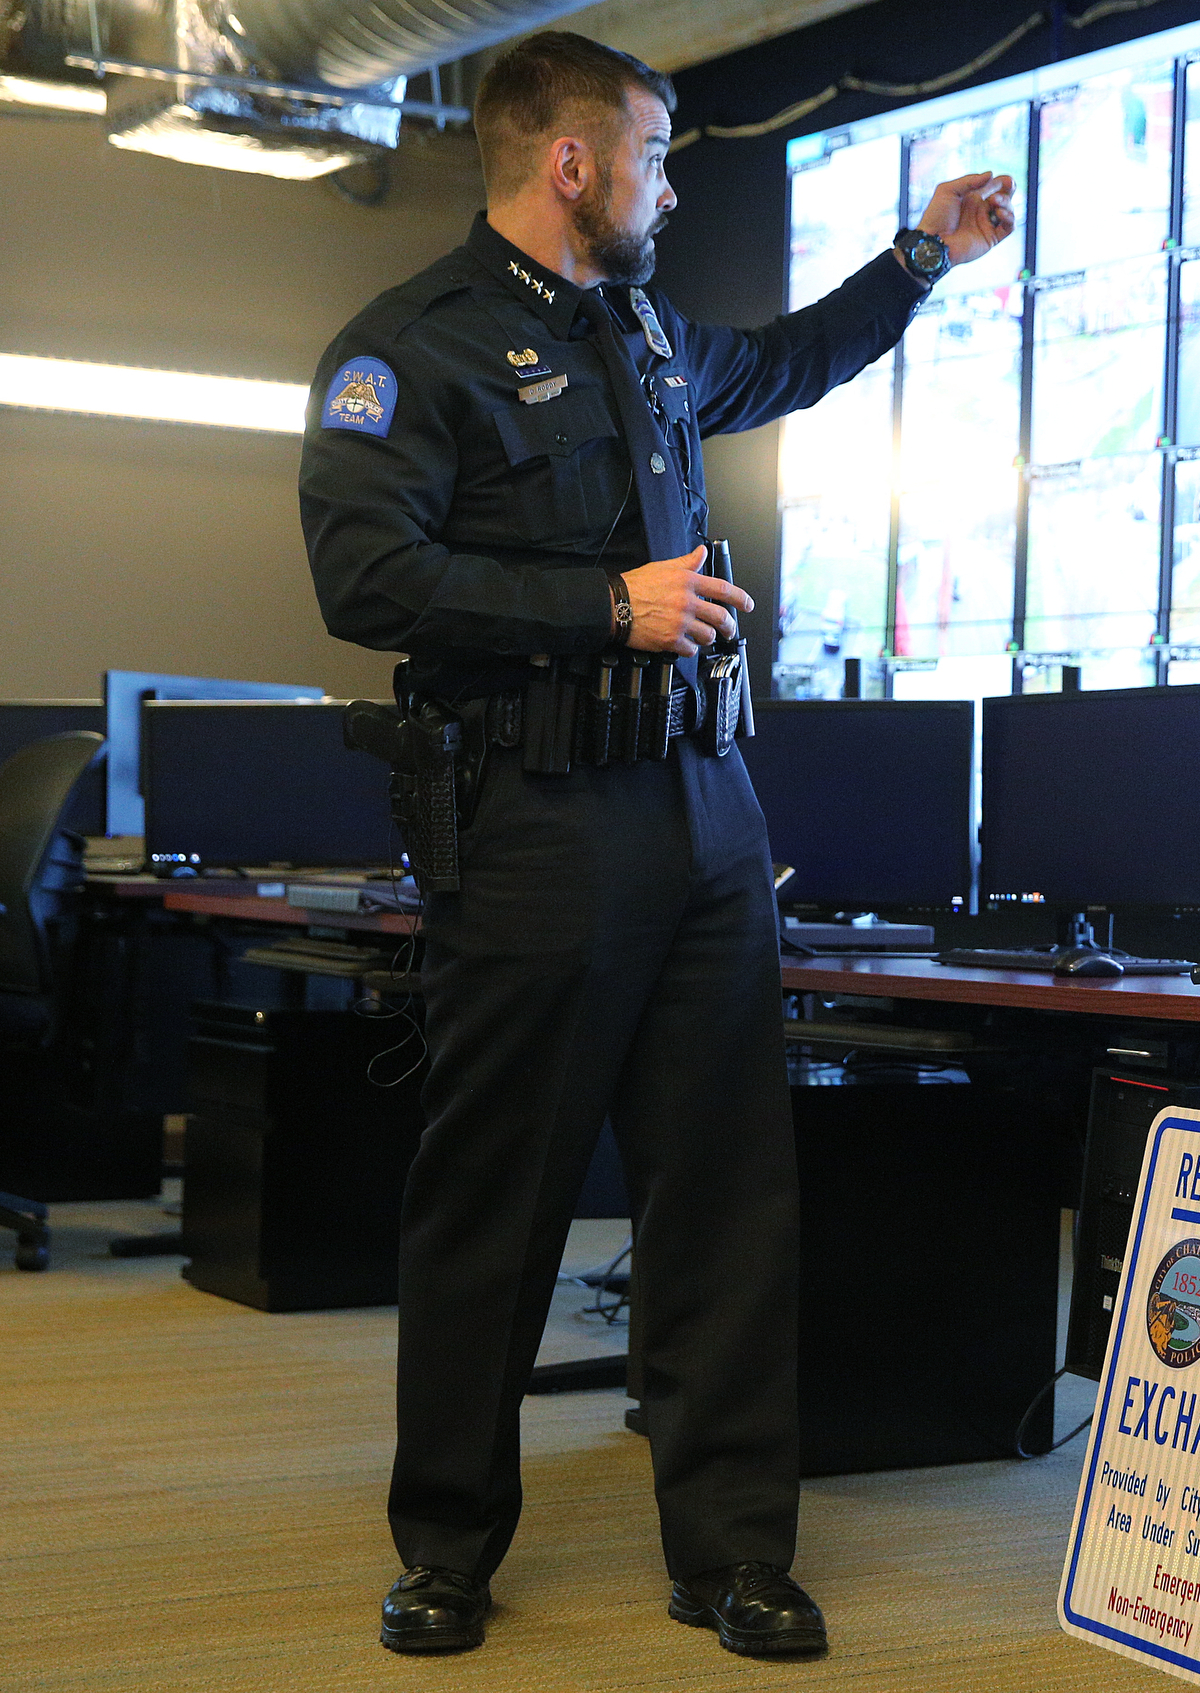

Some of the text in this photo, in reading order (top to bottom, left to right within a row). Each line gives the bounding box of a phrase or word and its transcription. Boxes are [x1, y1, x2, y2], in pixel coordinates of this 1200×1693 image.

[343, 370, 387, 388] S.W.A.T.
[339, 412, 365, 425] TEAM
[1155, 1269, 1168, 1290] CITY
[1166, 1256, 1175, 1268] OF
[1100, 1460, 1148, 1497] Provided
[1156, 1478, 1171, 1511] by
[1106, 1504, 1132, 1534] Area
[1142, 1514, 1175, 1548] Under
[1107, 1586, 1194, 1648] Non-Emergency
